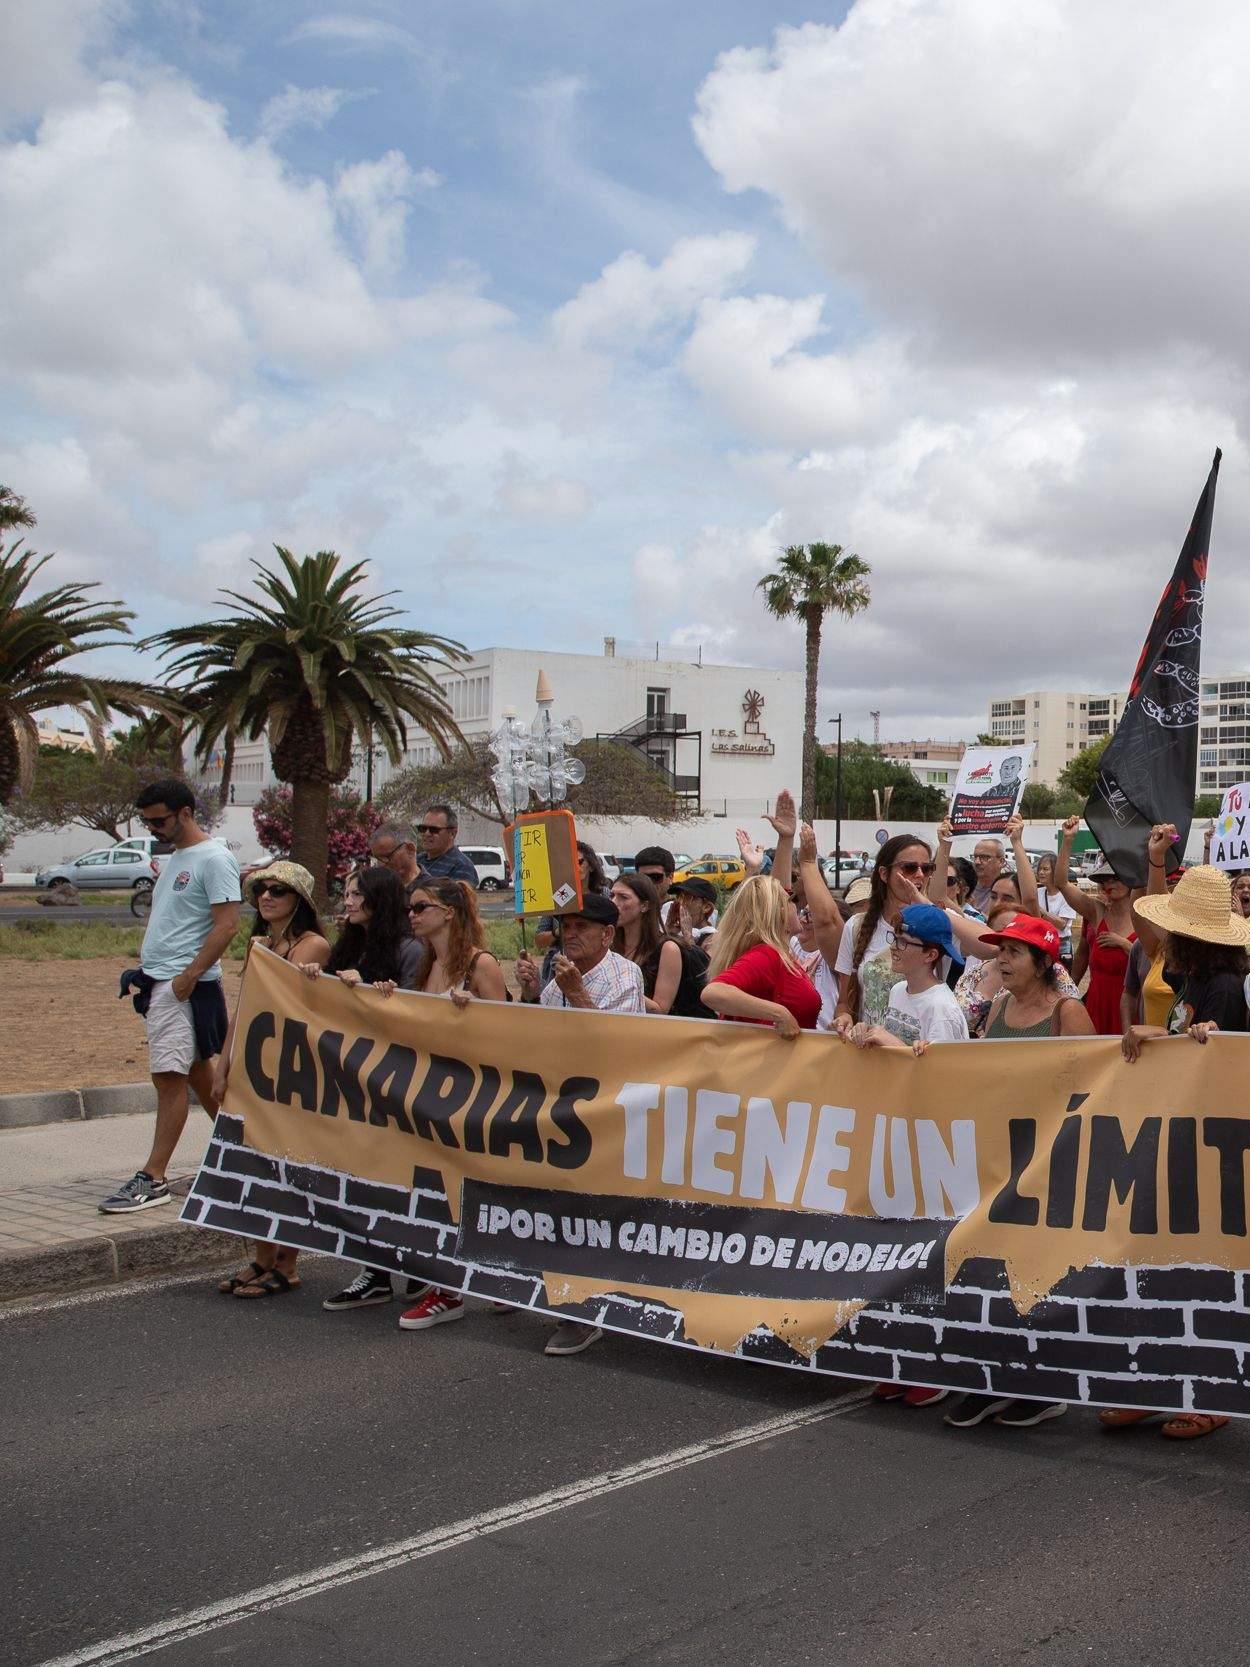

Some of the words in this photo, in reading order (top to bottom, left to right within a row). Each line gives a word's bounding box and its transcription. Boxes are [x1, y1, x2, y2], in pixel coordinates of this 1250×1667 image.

[711, 742, 729, 751] Las
[963, 808, 985, 818] lucha
[1235, 815, 1246, 836] Y
[1216, 842, 1226, 862] A
[1230, 840, 1250, 860] LA
[244, 1011, 600, 1171] CANARIAS
[615, 1082, 856, 1213] TIENE
[868, 1113, 981, 1220] UN
[476, 1204, 556, 1243] ¡POR
[561, 1216, 612, 1249] UN
[618, 1222, 748, 1263] CAMBIO
[749, 1235, 796, 1268] DE
[796, 1239, 937, 1273] MODELO!
